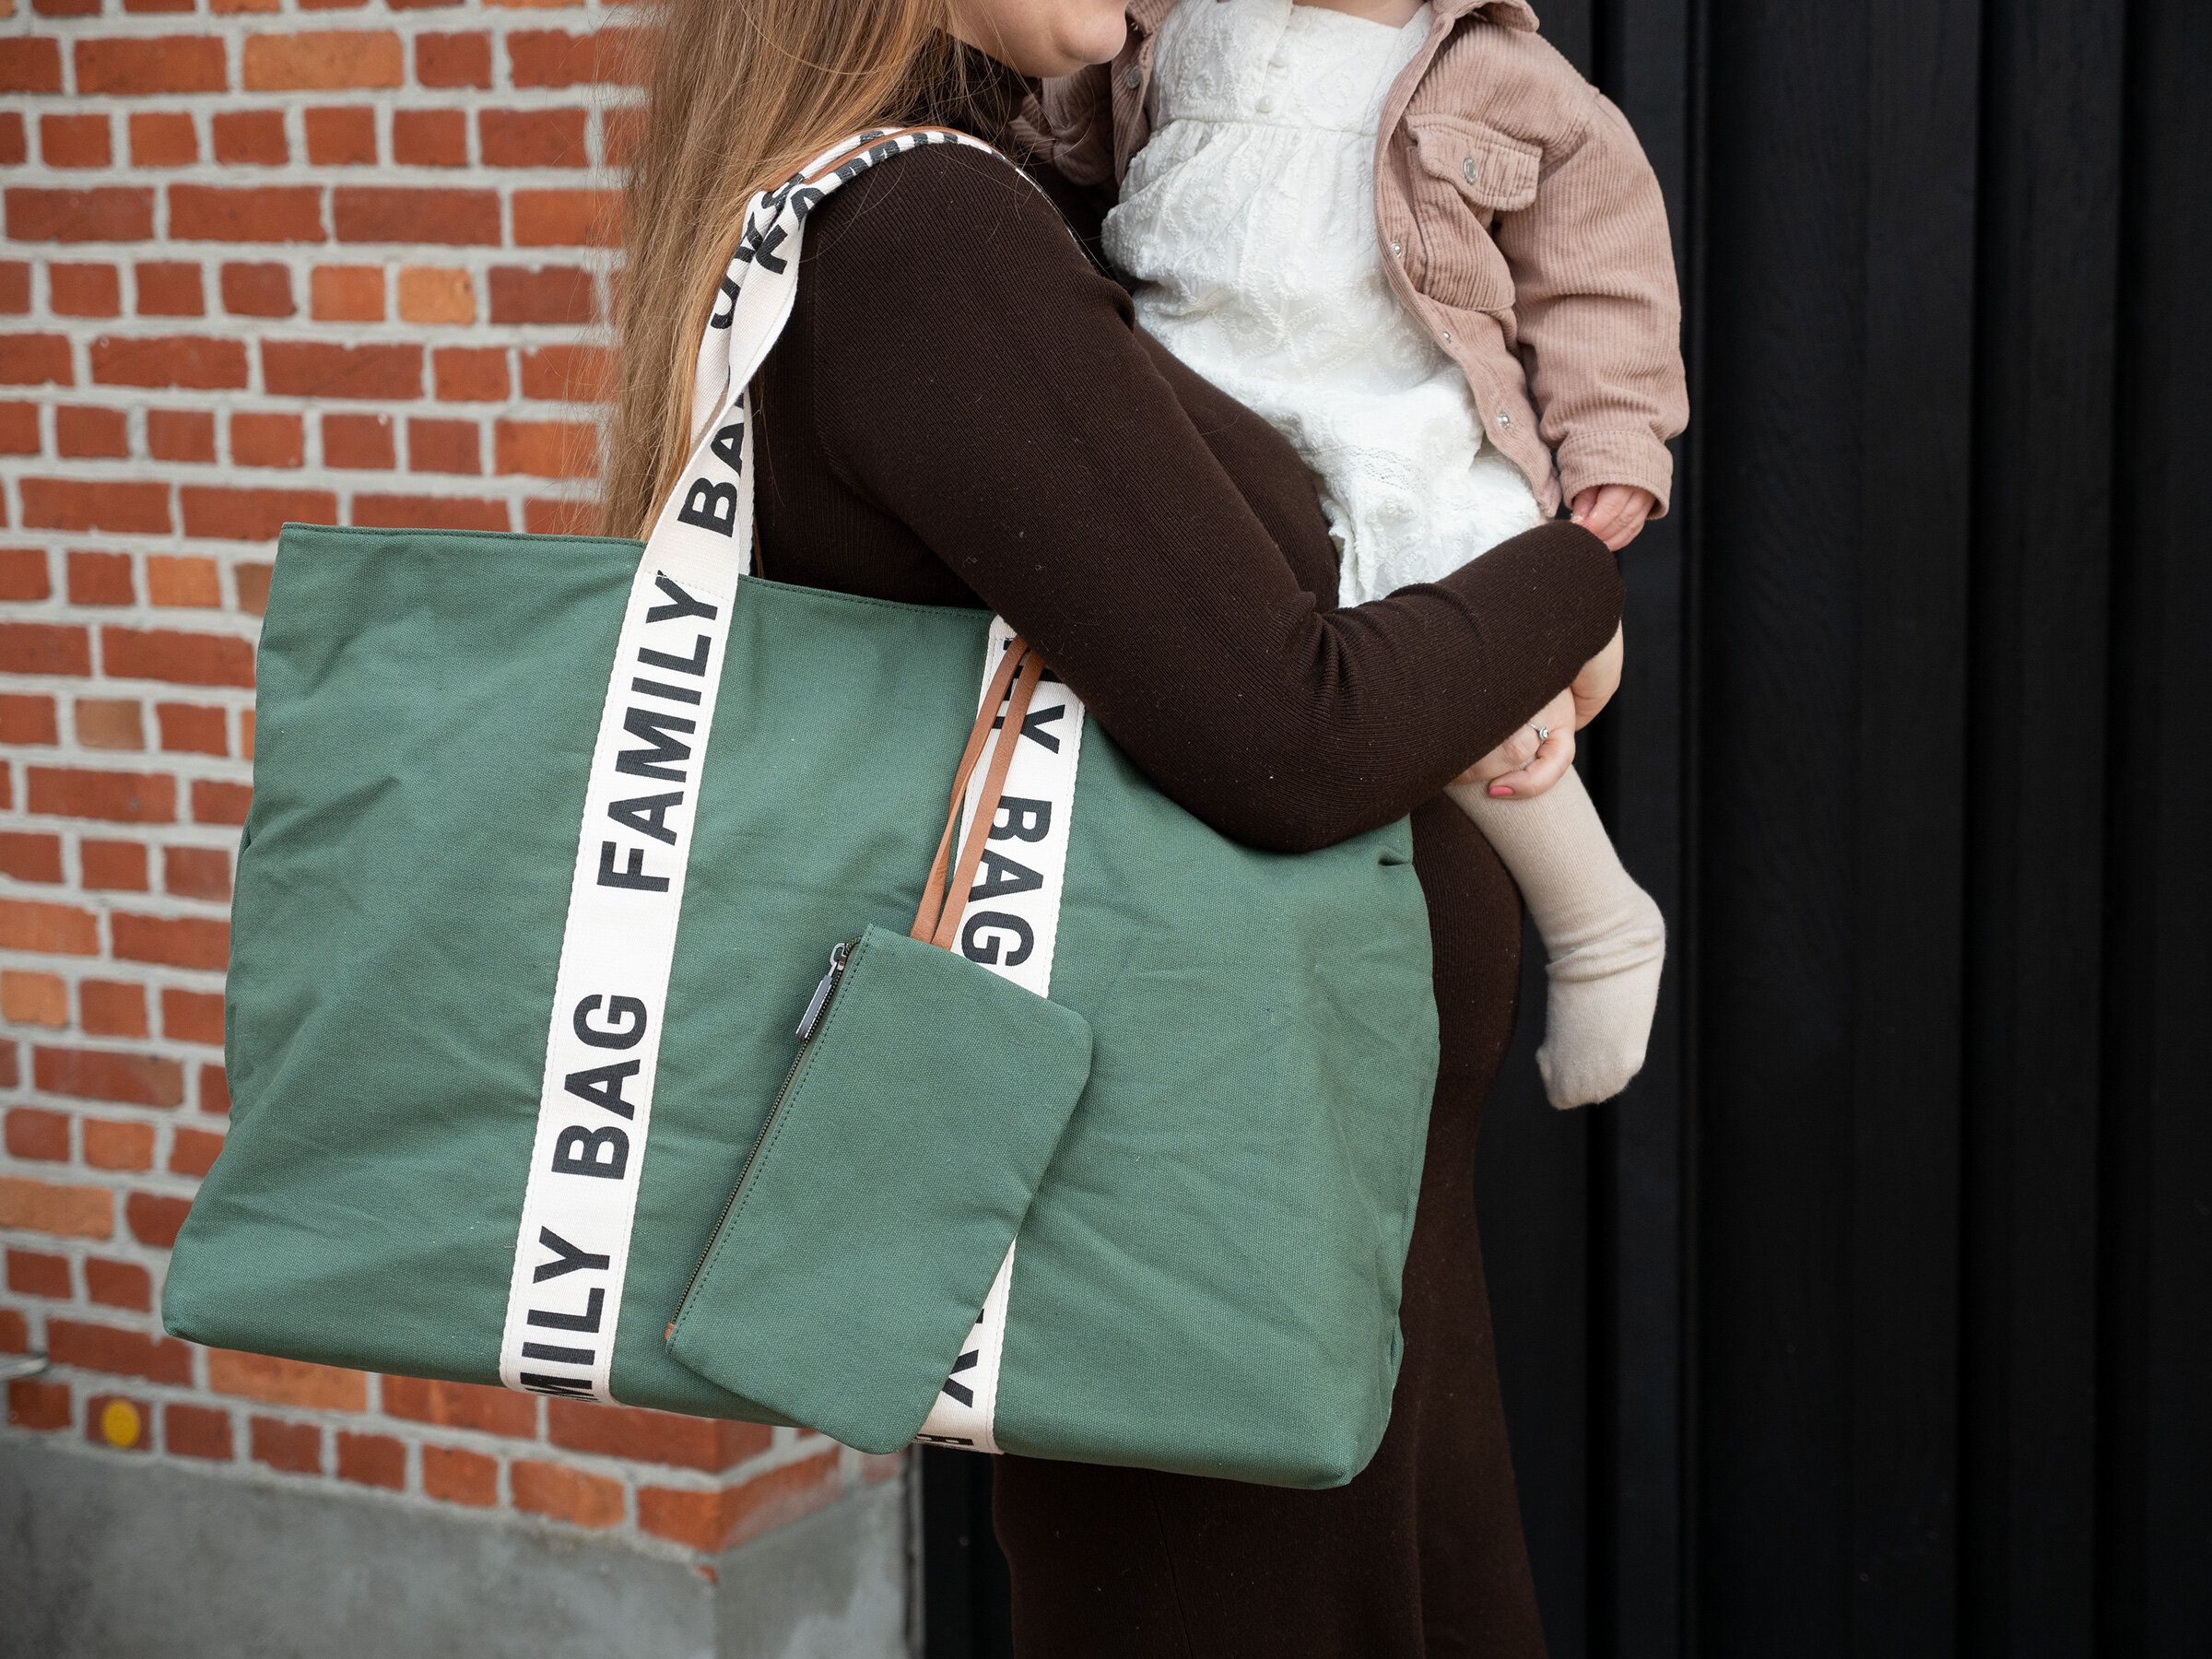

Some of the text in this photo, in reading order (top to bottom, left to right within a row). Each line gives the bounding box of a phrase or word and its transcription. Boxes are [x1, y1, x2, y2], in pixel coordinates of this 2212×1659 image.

[677, 393, 745, 537] BA
[596, 570, 718, 892] FAMILY
[961, 795, 1053, 967] BAG
[551, 994, 647, 1180] BAG
